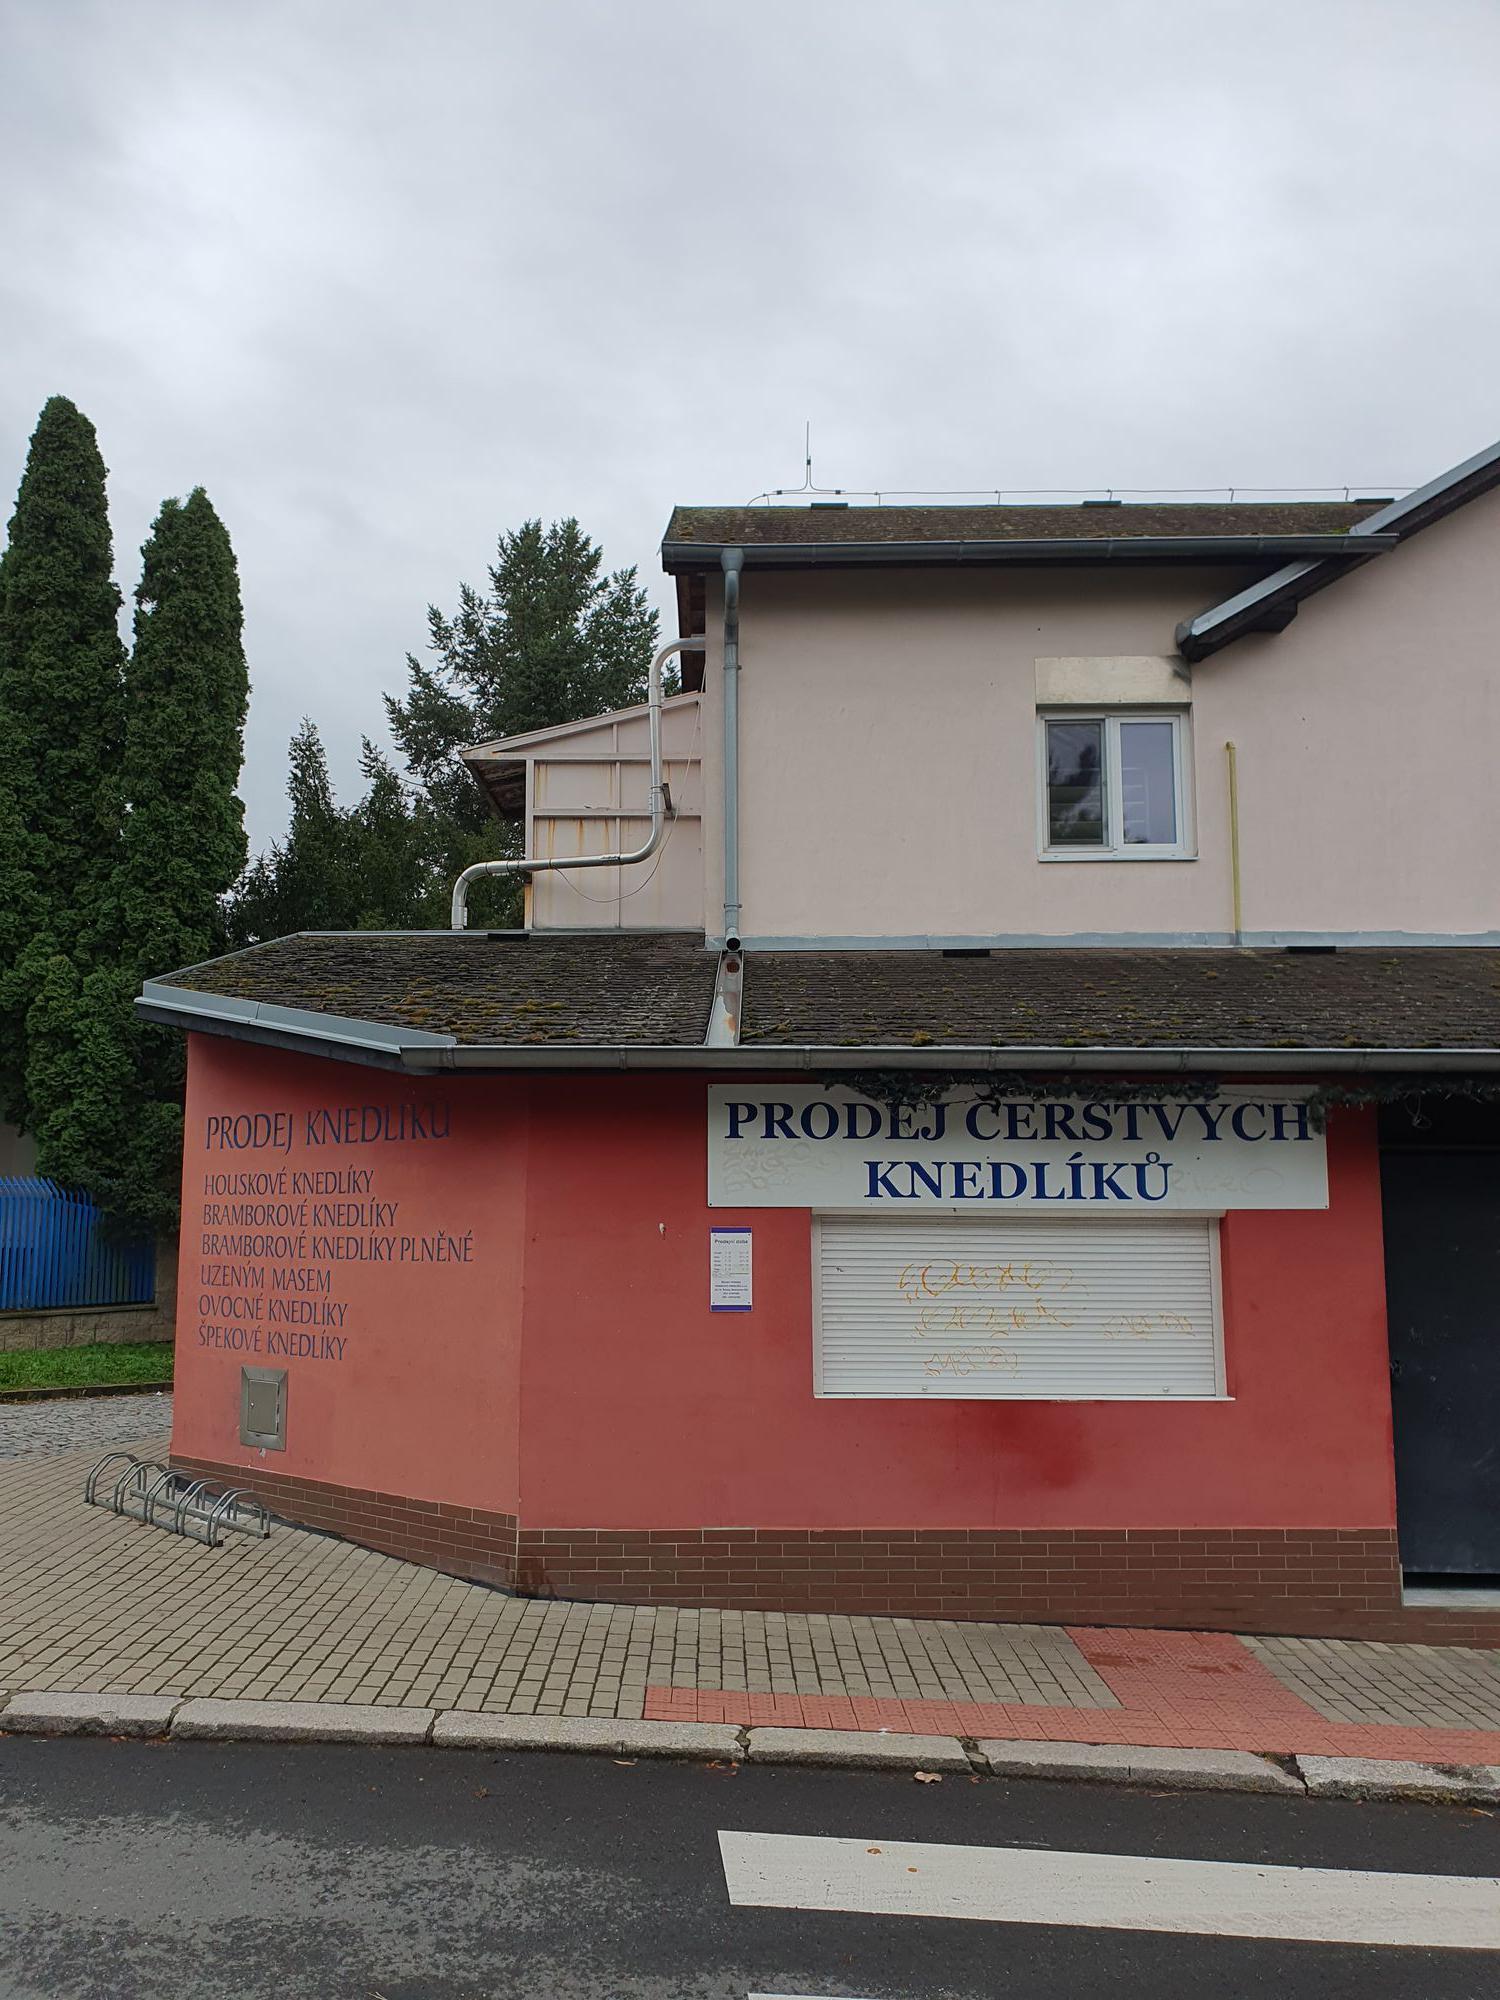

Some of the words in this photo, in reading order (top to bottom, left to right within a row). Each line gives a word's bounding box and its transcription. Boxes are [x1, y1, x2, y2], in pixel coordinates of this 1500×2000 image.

[206, 1112, 293, 1155] PRODEJ
[724, 1101, 949, 1140] PRODEJ
[204, 1166, 288, 1196] HOUSKOVÉ
[292, 1164, 374, 1195] KNEDLÍKY
[863, 1152, 1173, 1201] KNEDLÍKŮ
[203, 1198, 308, 1227] BRAMBOROVÉ
[312, 1197, 398, 1227] KNEDLÍKY
[202, 1229, 307, 1259] BRAMBOROVÉ
[312, 1230, 397, 1261] KNEDLÍKY
[400, 1229, 474, 1262] PLNĚNÉ
[200, 1260, 265, 1289] UZENÝM
[272, 1267, 331, 1293] MASEM
[199, 1292, 264, 1321] OVOCNÉ
[267, 1296, 348, 1327] KNEDLÍKY
[198, 1319, 262, 1352] ŠPEKOVÉ
[267, 1329, 347, 1361] KNEDLÍKY
